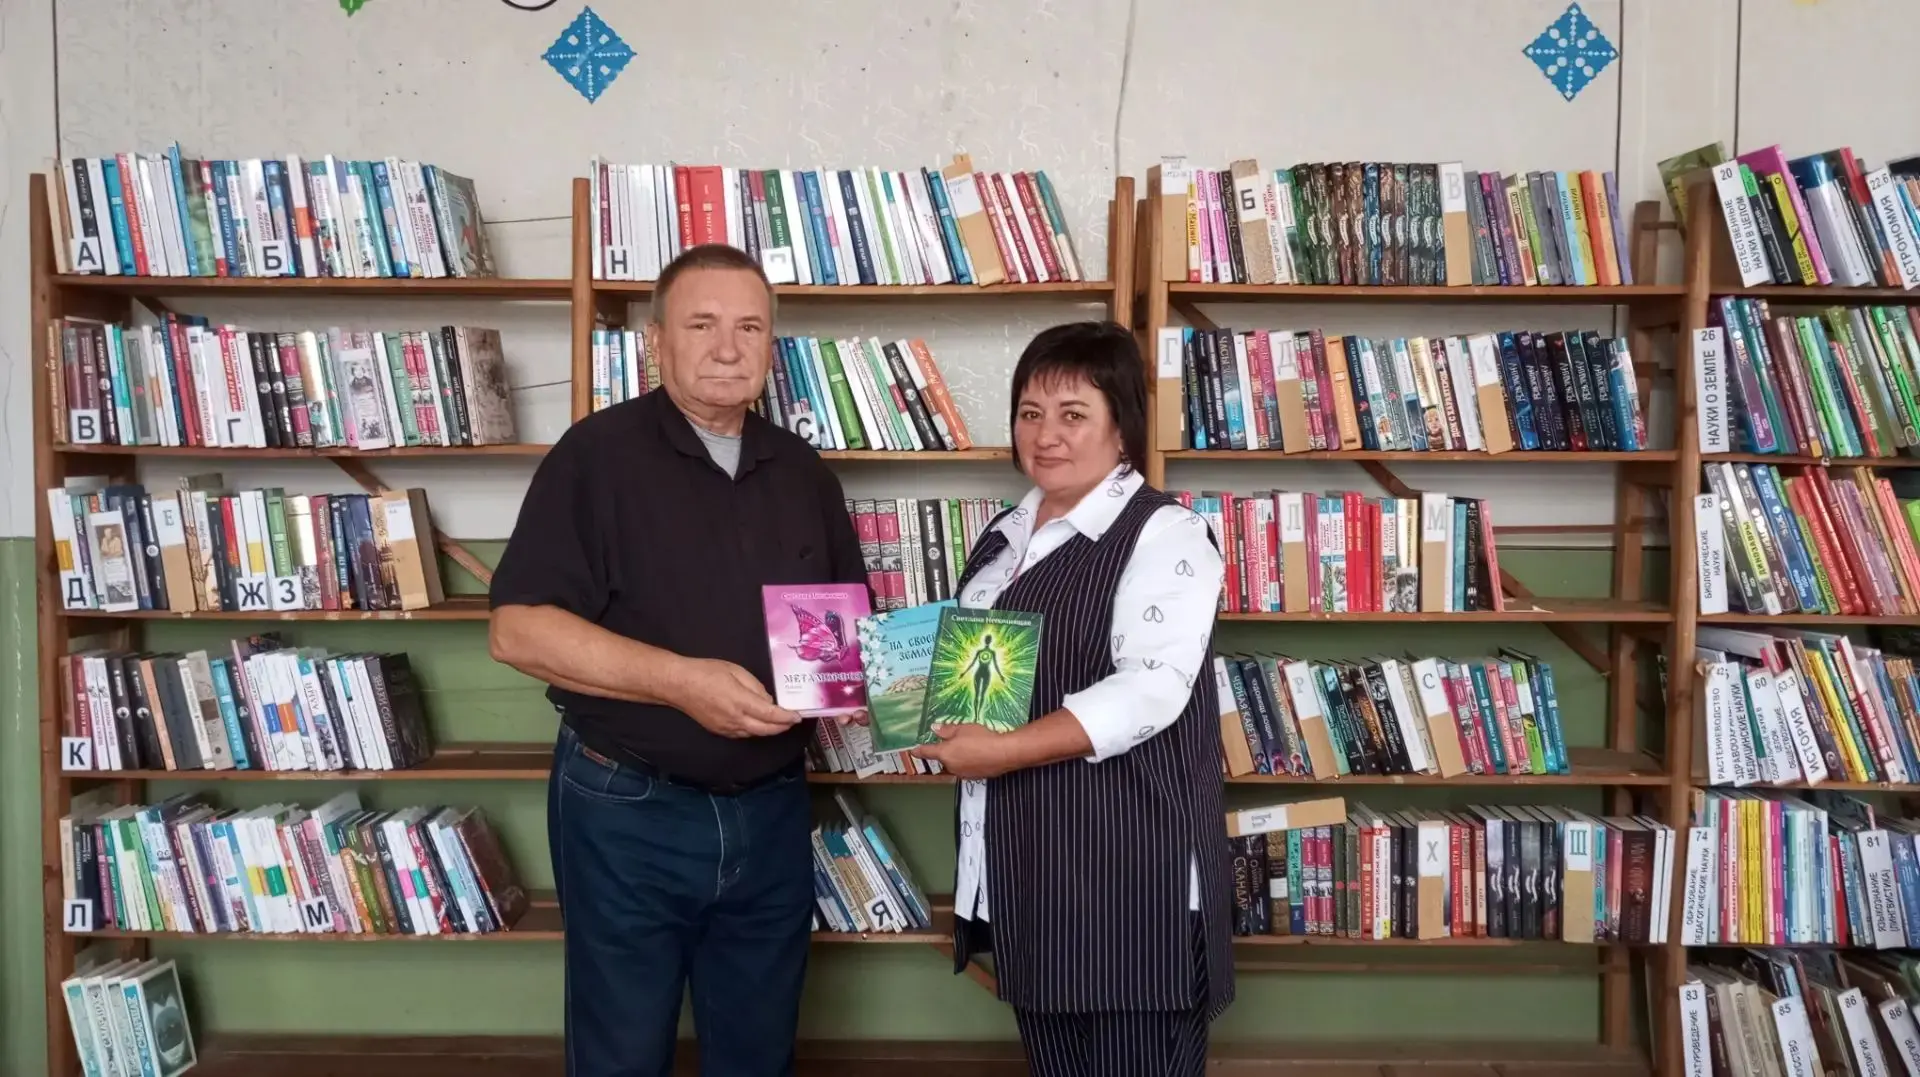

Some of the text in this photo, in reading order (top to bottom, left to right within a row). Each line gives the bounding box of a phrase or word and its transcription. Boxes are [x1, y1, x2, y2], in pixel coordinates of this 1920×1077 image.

[1445, 172, 1462, 200] В
[1720, 167, 1733, 181] 20
[1240, 188, 1257, 211] Б
[1736, 195, 1754, 227] ЦЕЛОМ
[1725, 199, 1749, 274] ЕСТЕСТВЕННЫЕ
[1880, 195, 1920, 285] АСТРОНОМИЯ
[77, 241, 97, 267] А
[263, 245, 282, 271] Б
[611, 250, 627, 274] Н
[1749, 238, 1762, 270] НАУКИ
[1701, 329, 1716, 342] 26
[1163, 337, 1179, 366] Г
[1278, 340, 1297, 374] Д
[1703, 350, 1721, 446] НАУКИ О ЗЕМЛЕ
[77, 415, 96, 440] В
[227, 418, 242, 443] Г
[795, 417, 814, 441] С
[1700, 497, 1714, 509] 28
[1286, 502, 1302, 531] Л
[1426, 507, 1446, 531] М
[1743, 520, 1768, 577] ДИНОЗАВРЫ
[1699, 529, 1713, 599] БИОЛОГИЧЕСКИЕ
[68, 577, 87, 607] Д
[239, 581, 266, 607] Ж
[279, 579, 296, 604] З
[889, 631, 937, 651] НА СВОЕ
[1291, 676, 1305, 697] Р
[1422, 673, 1436, 690] С
[1754, 676, 1768, 690] 60
[1240, 711, 1256, 745] КАРЕТА
[1716, 687, 1725, 780] РАСТЕНИЕВОДСТВО
[1735, 682, 1756, 780] МЕДИЦИНСКИЕ НАУКИ
[1776, 706, 1797, 769] ОБЩЕСТВОЗНАНИЕ
[1790, 706, 1821, 774] ИСТОРИЯ
[69, 742, 86, 766] К
[1426, 840, 1439, 862] Х
[1866, 836, 1880, 848] 81
[1233, 856, 1249, 912] СКАНДАР
[1694, 847, 1710, 945] ПЕДАГОГИЧЕСКИЕ НАУКИ
[305, 901, 329, 927] М
[871, 900, 894, 927] Я
[1872, 871, 1887, 933] ЯЗЫКОЗНАНИЕ
[68, 904, 86, 927] Л
[1686, 990, 1698, 1001] 83
[1844, 995, 1857, 1008] 86
[1778, 1003, 1792, 1016] 85
